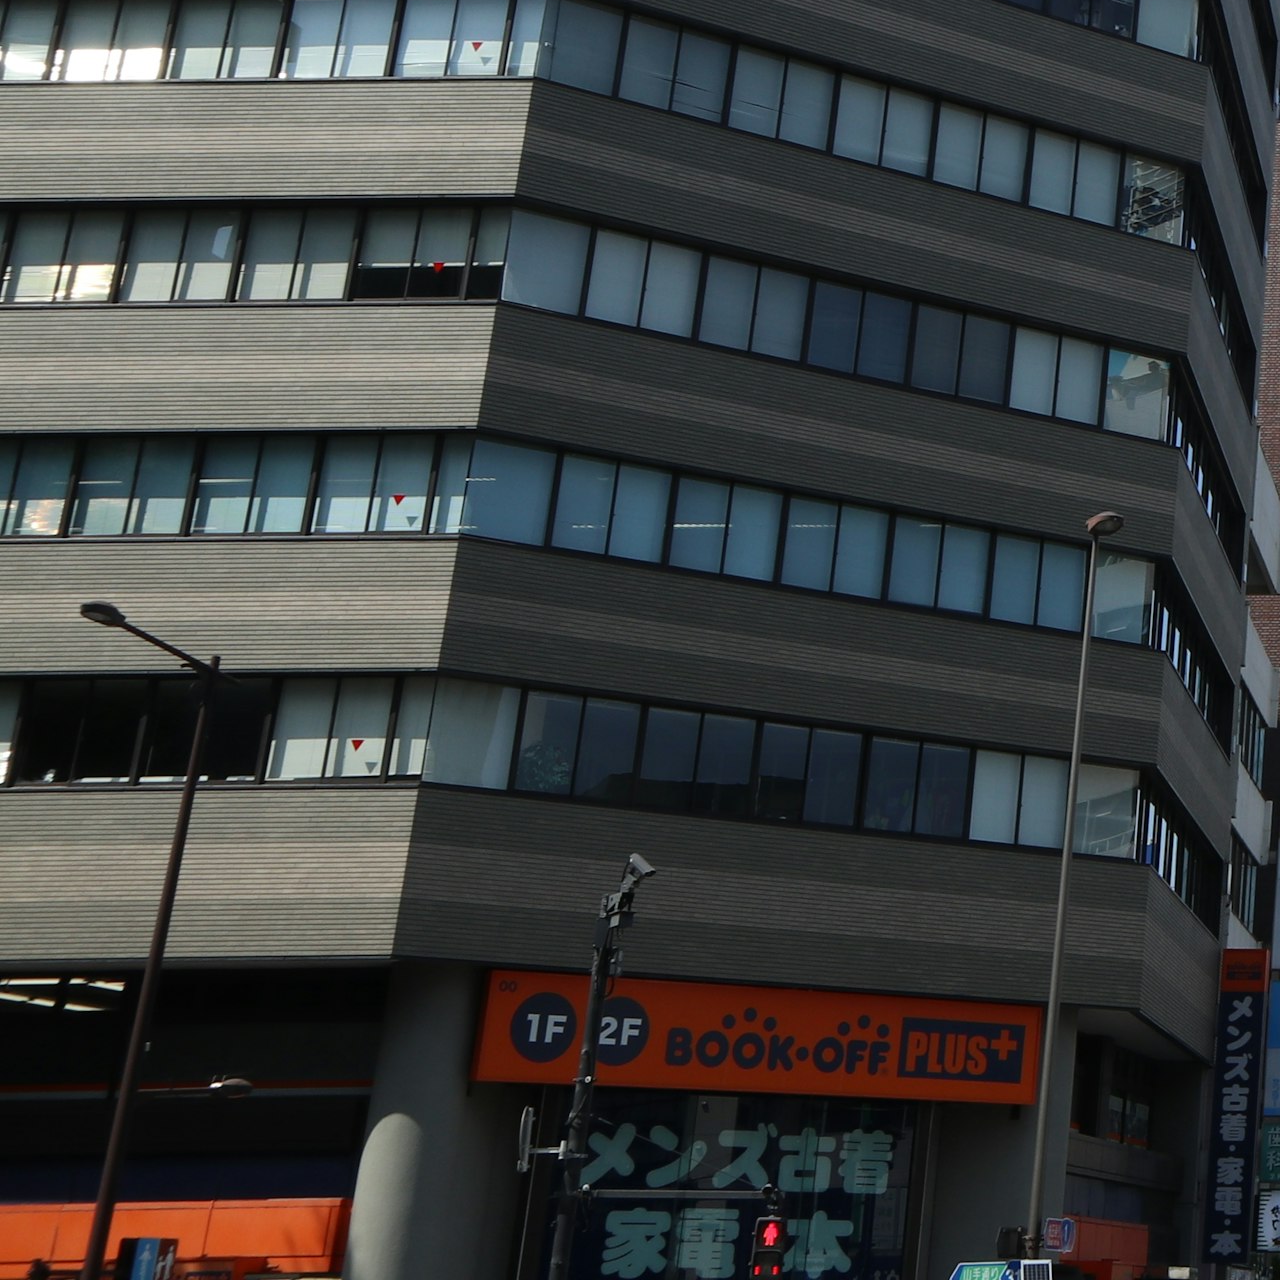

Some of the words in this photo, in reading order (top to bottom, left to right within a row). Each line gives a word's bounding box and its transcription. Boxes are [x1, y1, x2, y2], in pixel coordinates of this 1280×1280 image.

[527, 1013, 568, 1044] 1F
[598, 1016, 643, 1046] 2F
[1209, 994, 1256, 1257] メンズ古着・家電・本
[579, 1122, 895, 1195] メンズ古着
